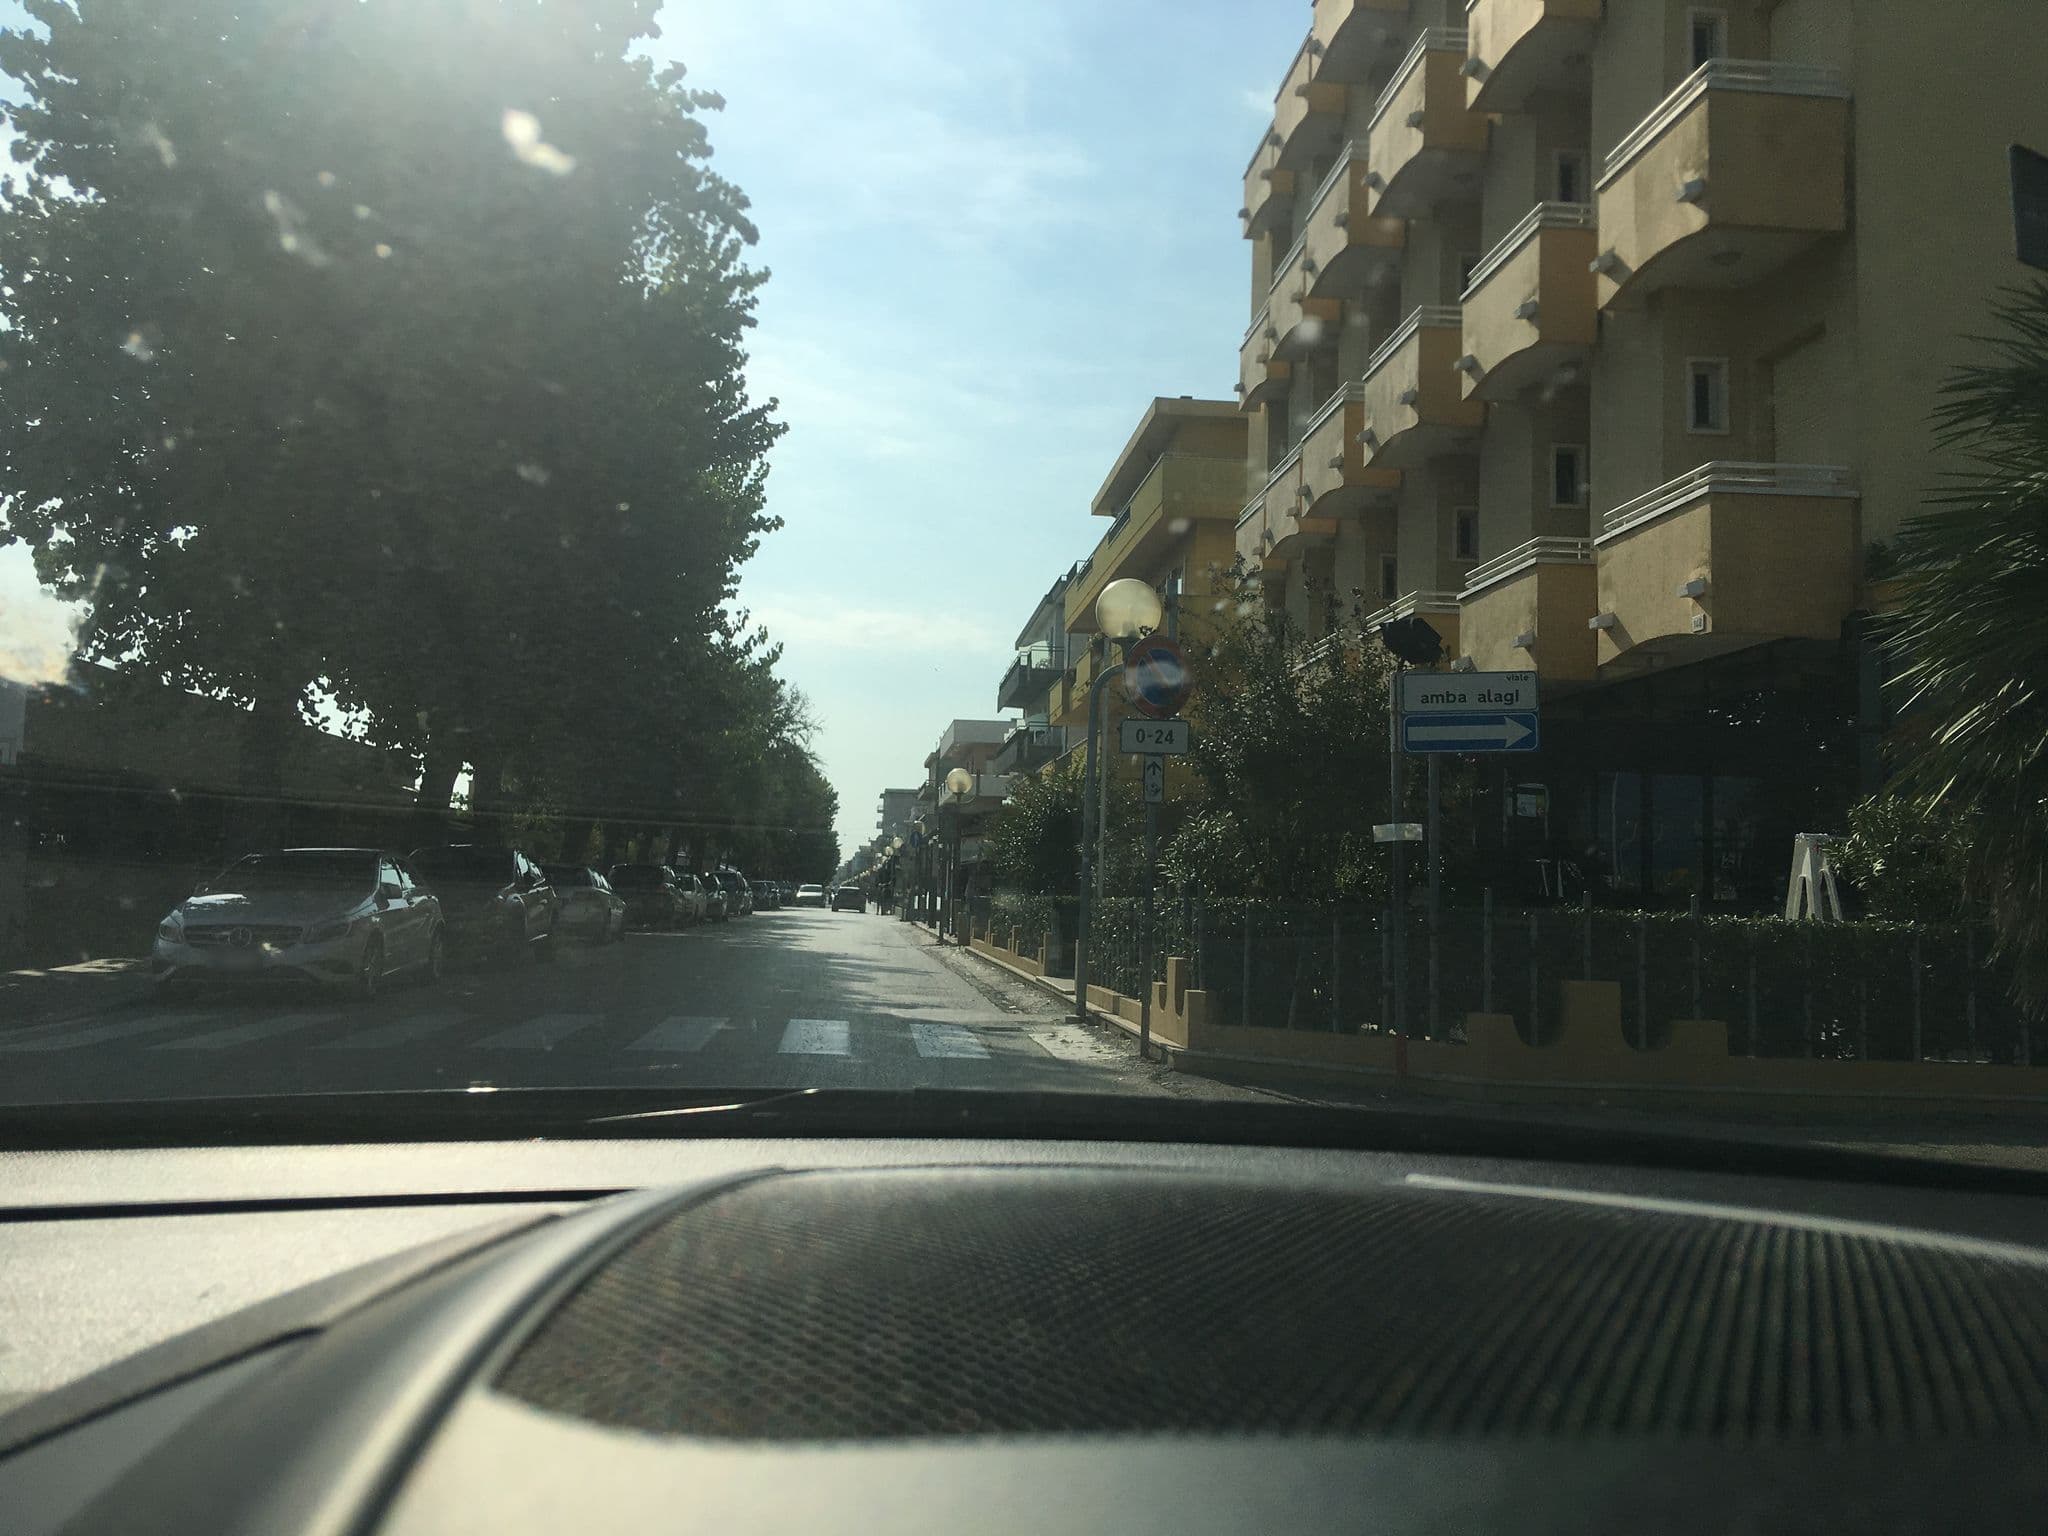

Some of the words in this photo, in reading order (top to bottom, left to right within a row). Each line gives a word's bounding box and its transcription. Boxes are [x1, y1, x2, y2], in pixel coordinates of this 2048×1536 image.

[1506, 674, 1529, 682] viale
[1420, 690, 1467, 704] amba
[1477, 689, 1519, 706] alagi
[1135, 728, 1175, 745] 0-24
